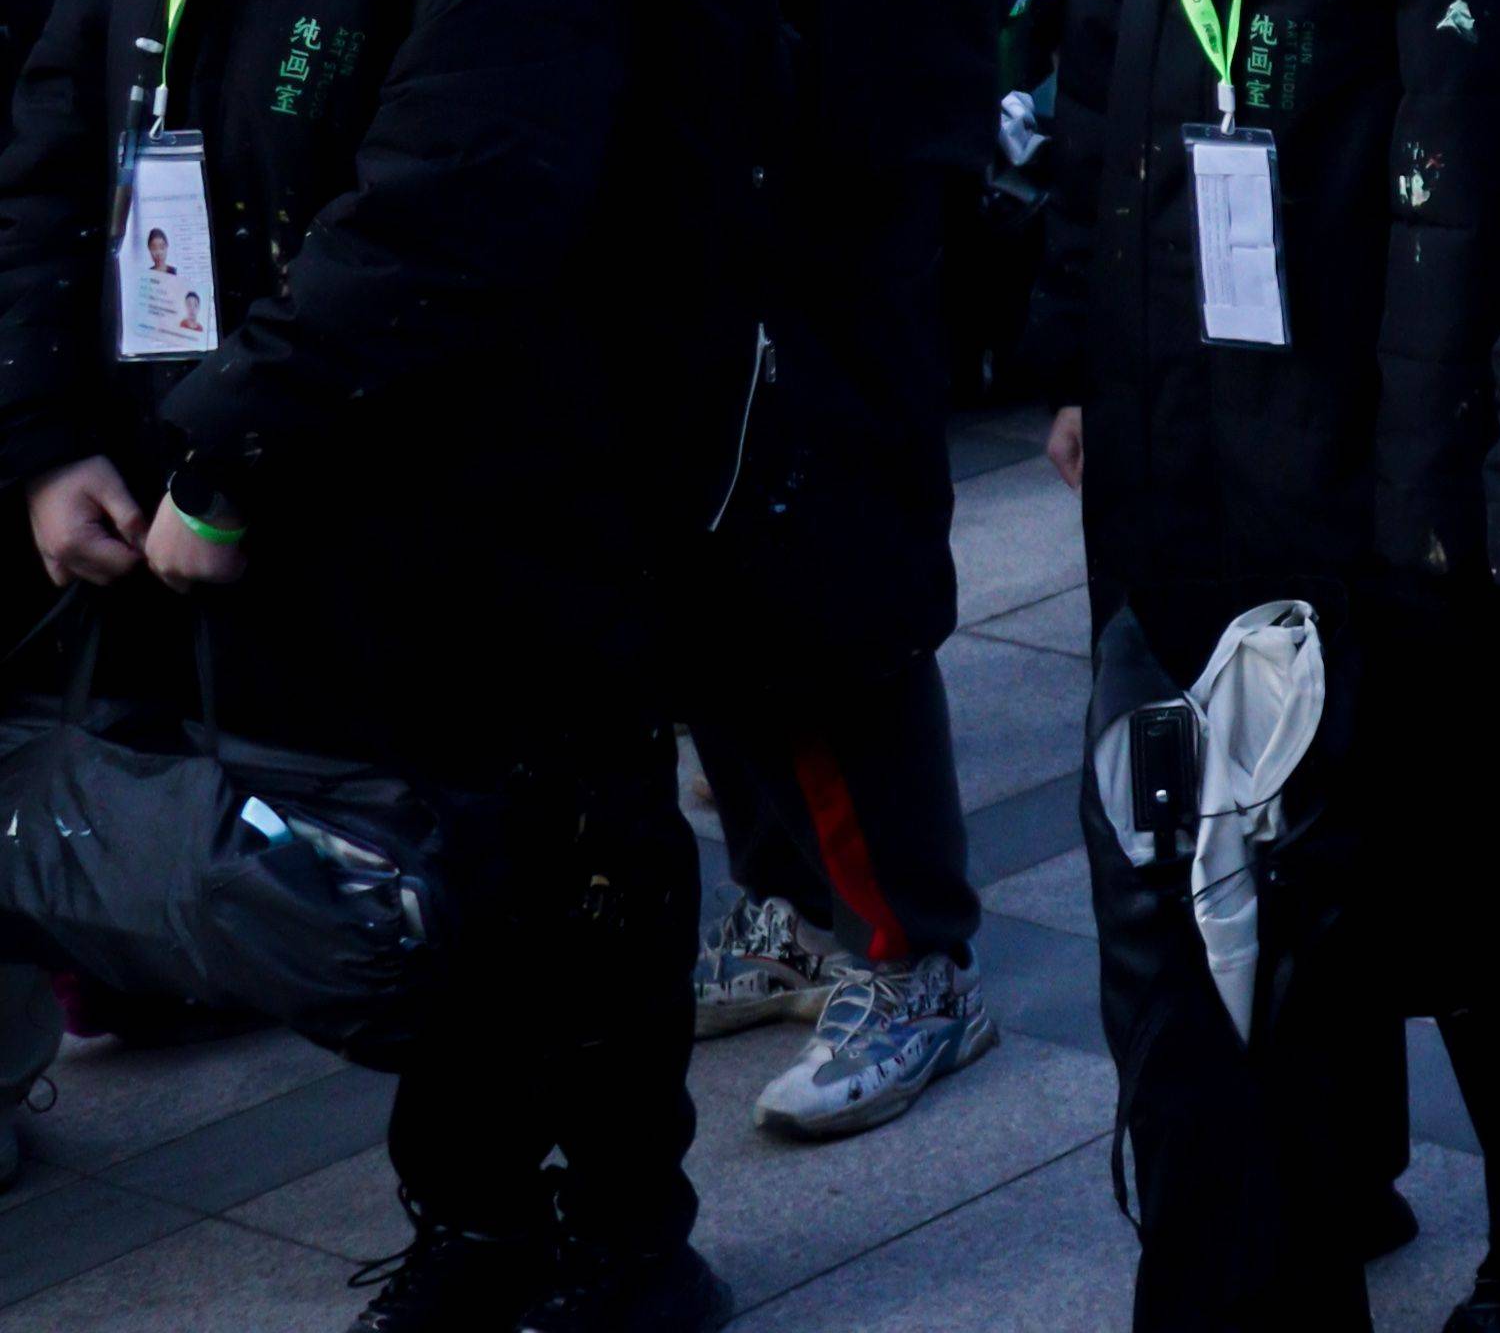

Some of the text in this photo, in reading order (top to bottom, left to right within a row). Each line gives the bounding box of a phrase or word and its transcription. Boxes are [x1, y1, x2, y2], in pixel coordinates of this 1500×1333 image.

[271, 16, 322, 117] 纯画室
[1244, 13, 1278, 110] 纯画室
[1302, 20, 1315, 65] CHUN
